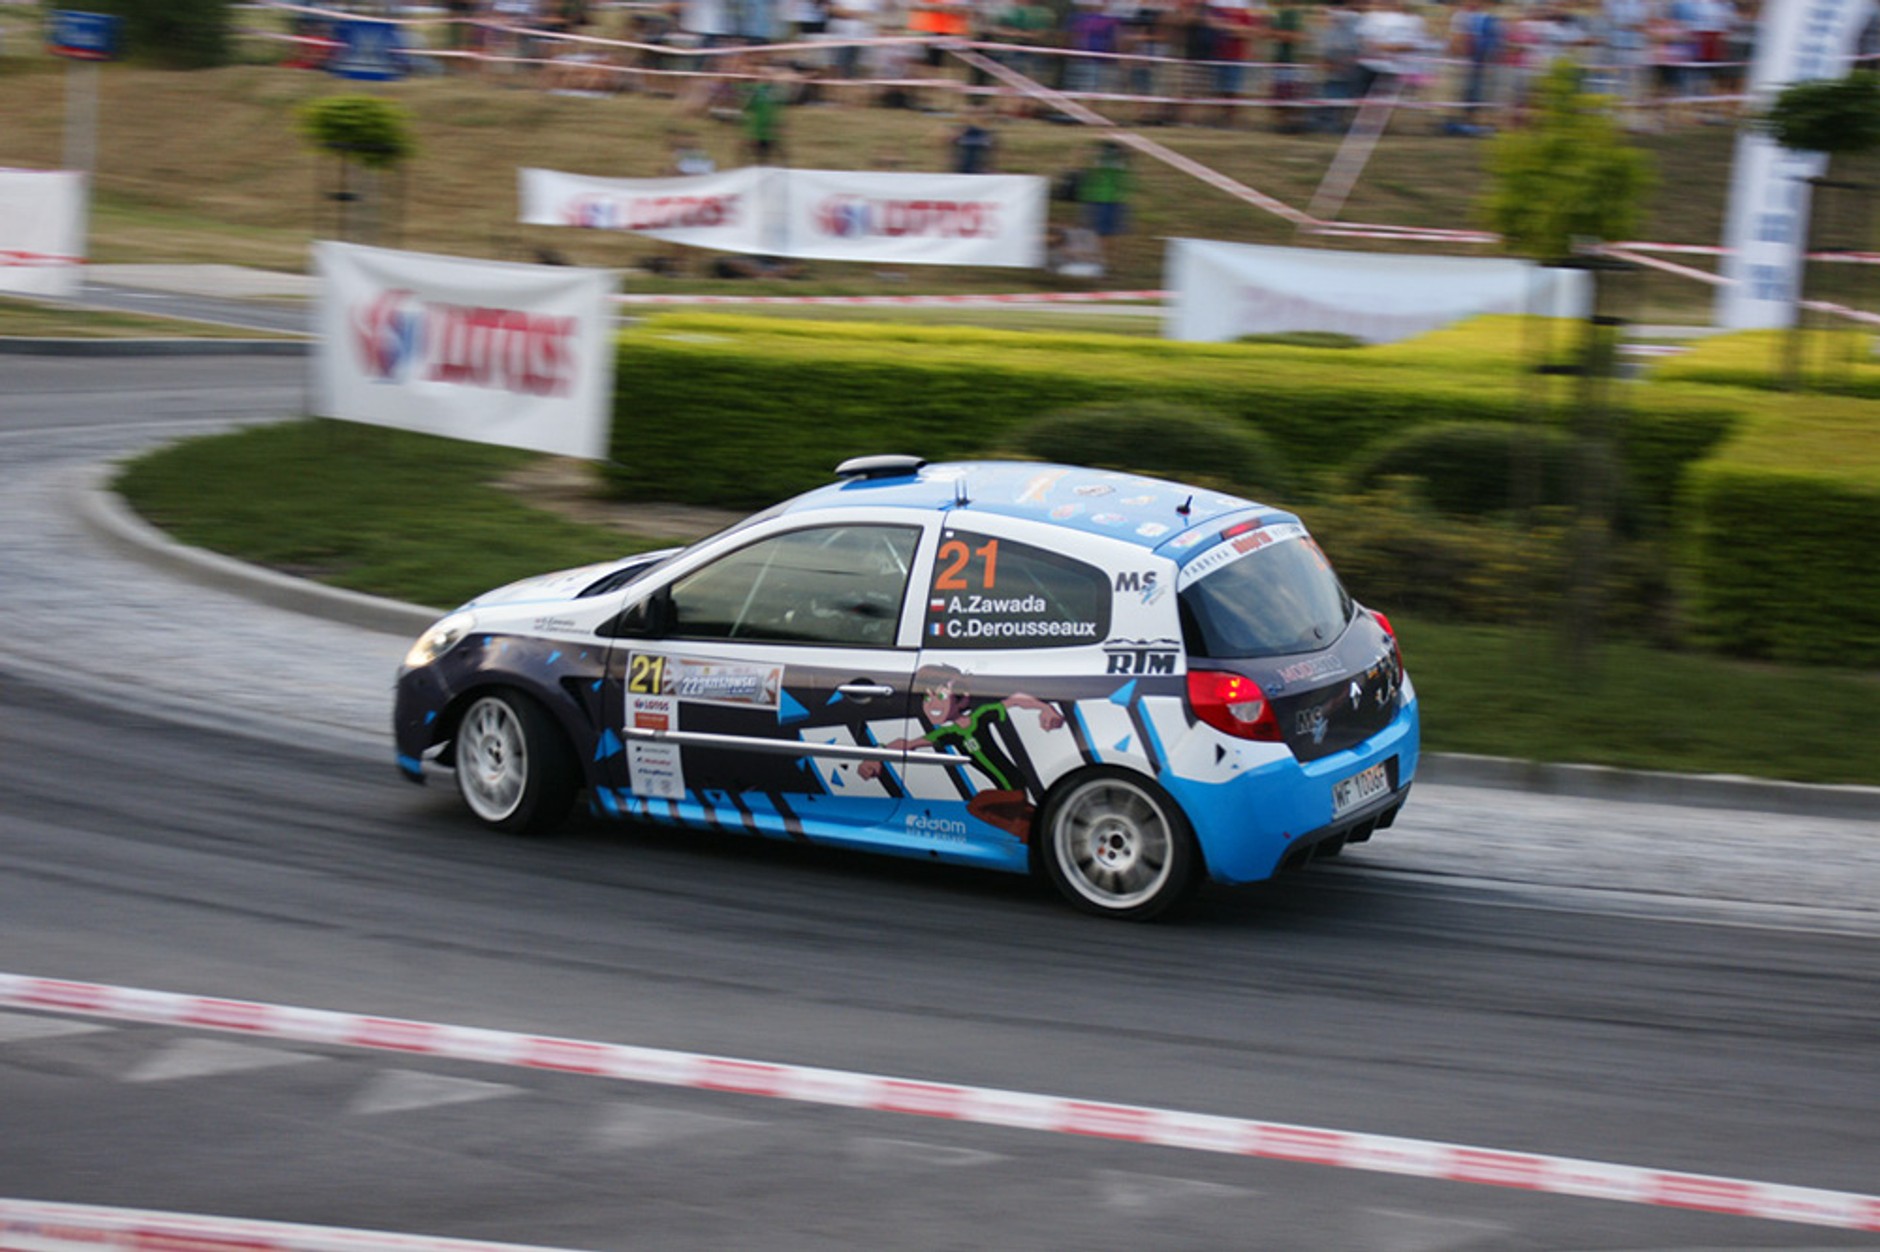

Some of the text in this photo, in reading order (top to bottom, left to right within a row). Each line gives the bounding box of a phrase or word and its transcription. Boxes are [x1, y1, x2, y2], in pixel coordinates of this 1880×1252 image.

[935, 540, 999, 590] 21
[947, 596, 1046, 613] A.Zawada
[947, 619, 1096, 638] C.Derousseaux
[1105, 649, 1177, 674] RTM
[628, 655, 664, 694] 21
